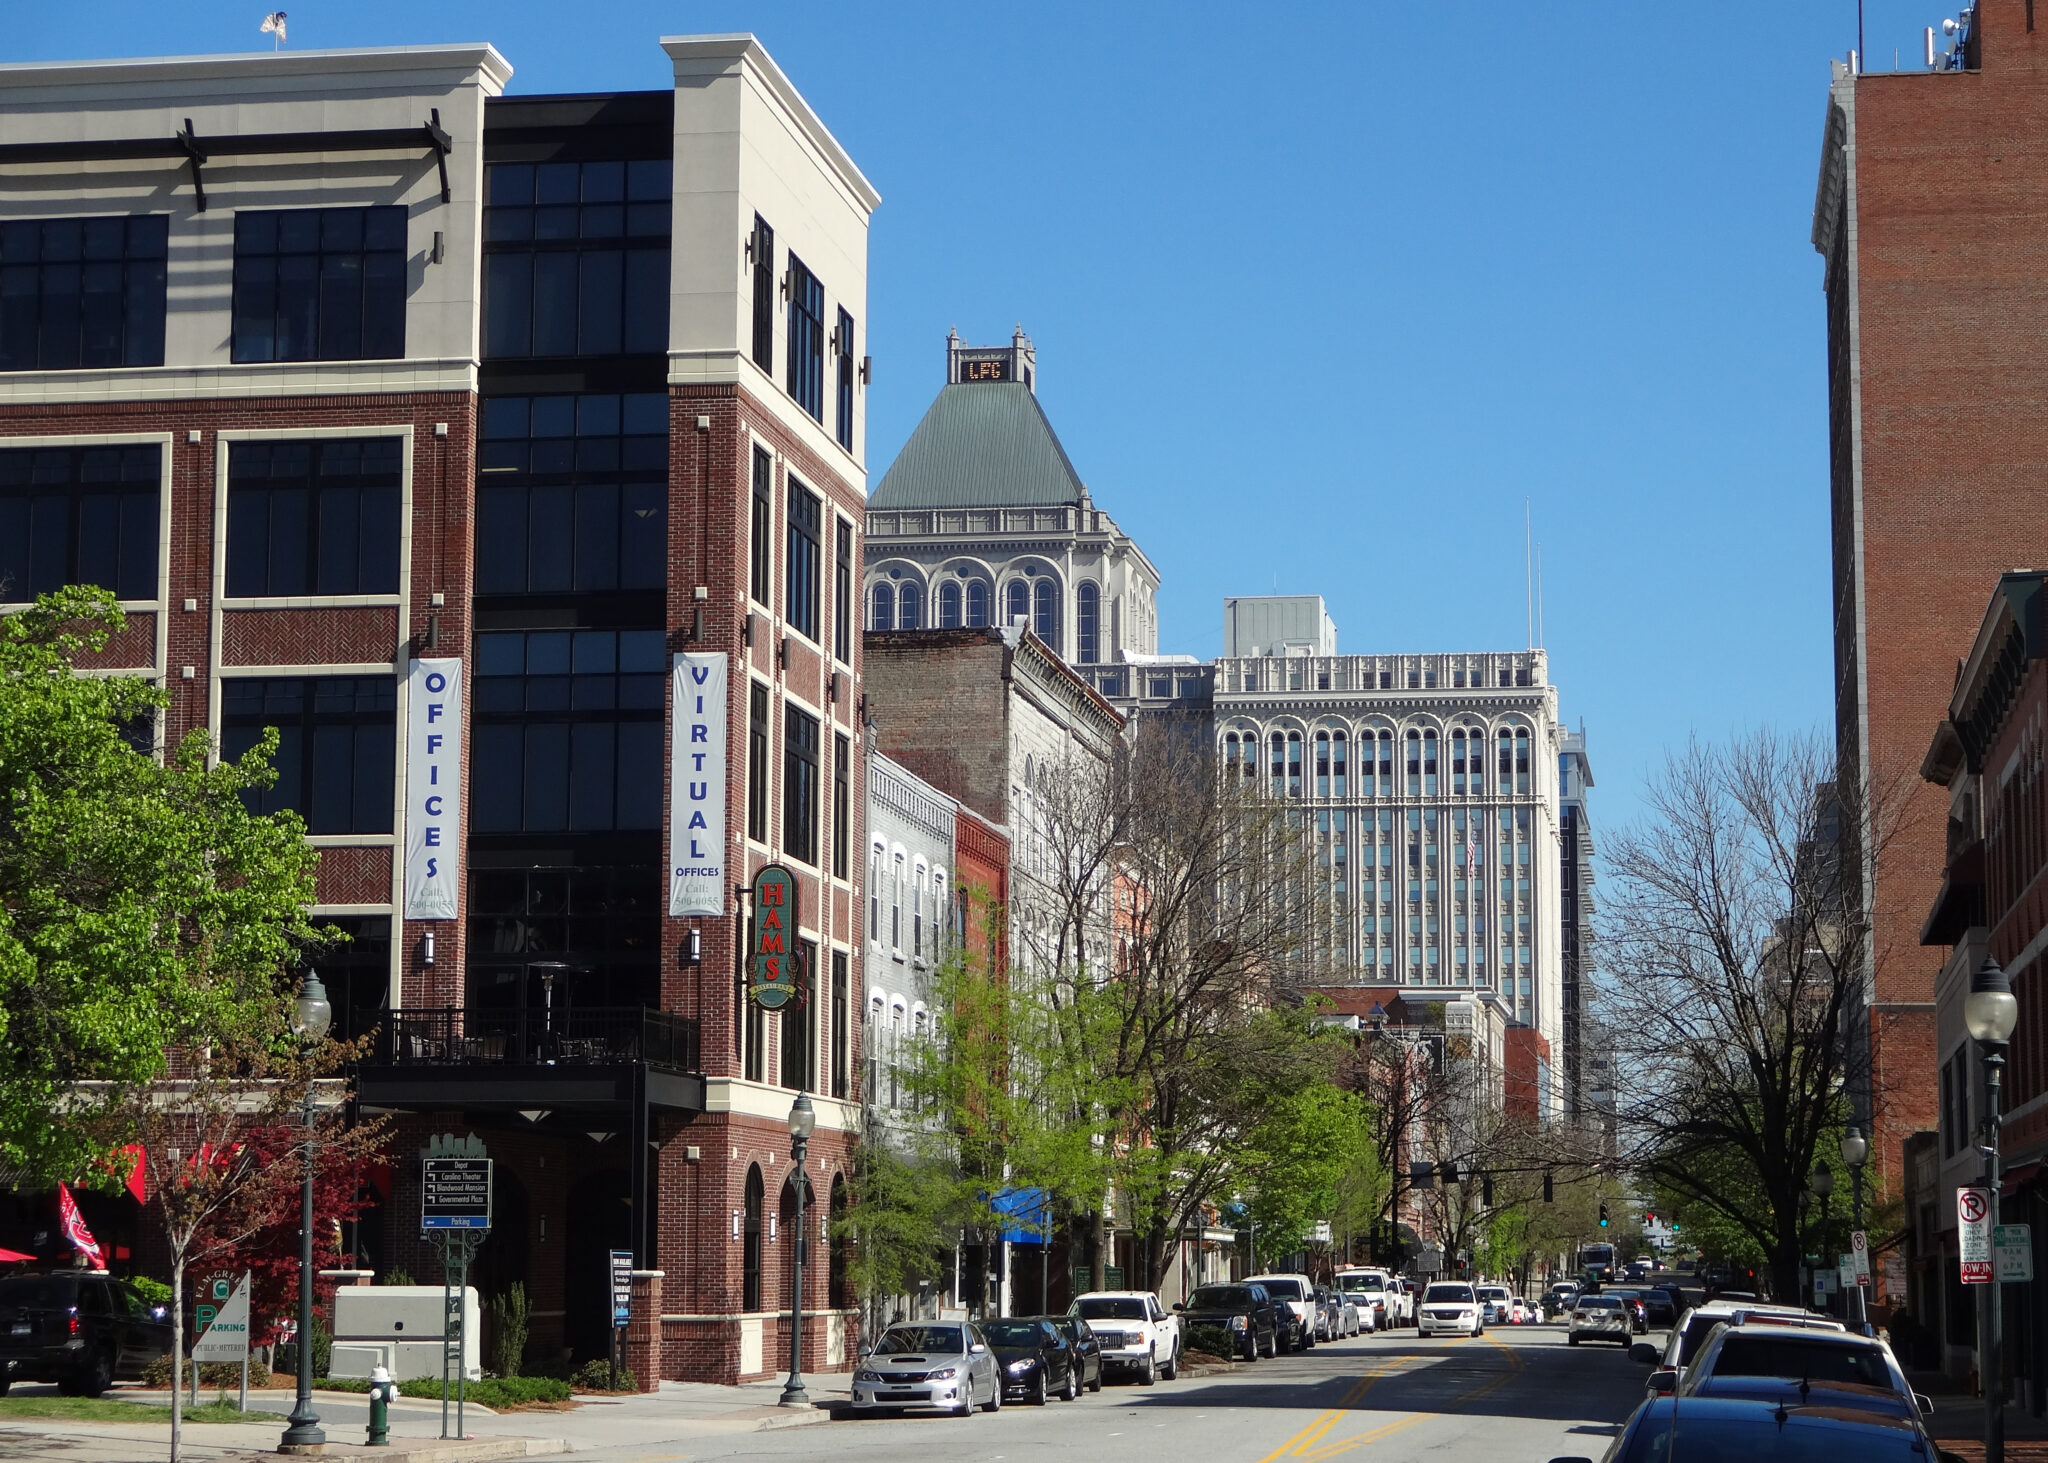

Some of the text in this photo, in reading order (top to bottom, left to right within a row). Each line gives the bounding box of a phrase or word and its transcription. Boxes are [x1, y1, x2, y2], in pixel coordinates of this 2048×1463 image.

[969, 362, 1001, 379] LFG
[688, 667, 709, 858] VIRTUAL
[425, 673, 446, 878] OFFICES
[676, 868, 719, 876] OFFICES
[686, 883, 709, 893] Call:
[759, 883, 785, 980] HAMS
[454, 1161, 468, 1170] Depot
[436, 1184, 464, 1192] Blandwood
[439, 1195, 483, 1203] Governmental Plaza
[452, 1218, 470, 1227] Parking
[1961, 1263, 1992, 1274] TOW-IN
